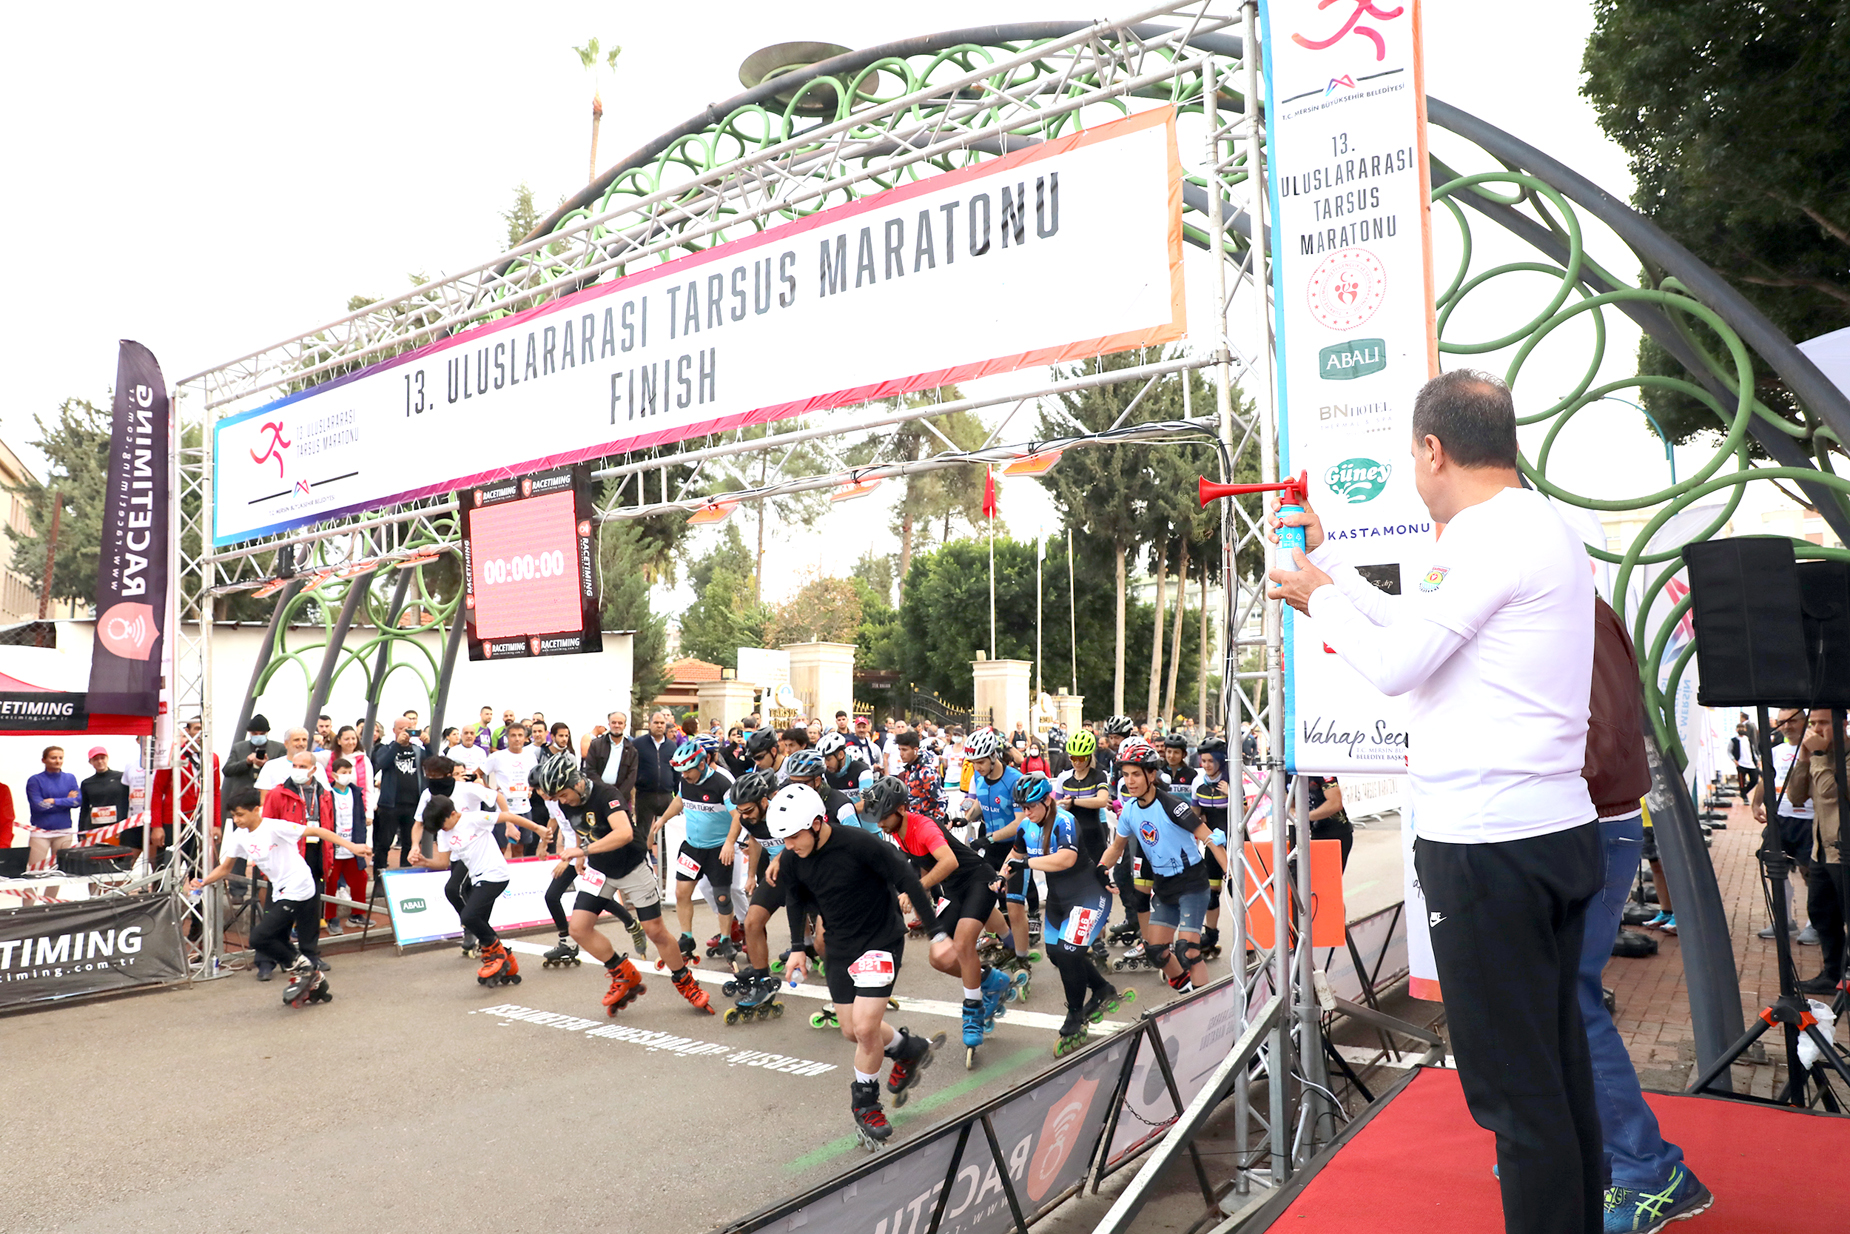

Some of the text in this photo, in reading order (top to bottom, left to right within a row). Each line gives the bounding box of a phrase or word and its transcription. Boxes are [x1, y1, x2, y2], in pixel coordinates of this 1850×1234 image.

[1331, 132, 1356, 157] 13.
[1281, 147, 1413, 197] ULUSLARARASI
[1314, 187, 1380, 222] TARSUS
[1300, 215, 1397, 255] MARATONU
[404, 171, 1059, 418] 13. ULUSLARARASI TARSUS MARATONU
[1326, 346, 1380, 370] ABALI
[610, 346, 716, 425] FINISH
[1319, 404, 1348, 421] BN
[532, 475, 571, 490] RACETIMING
[1325, 462, 1392, 487] Güney
[483, 485, 517, 500] RACETIMING
[1327, 522, 1431, 541] KASTAMONU
[484, 550, 564, 585] 00:00:00
[582, 537, 594, 597] RACETIMING
[492, 642, 526, 653] RACETIMING
[540, 638, 580, 649] RACETIMING
[1303, 717, 1366, 758] Vahap
[403, 901, 424, 910] ABALI
[858, 960, 881, 971] 921
